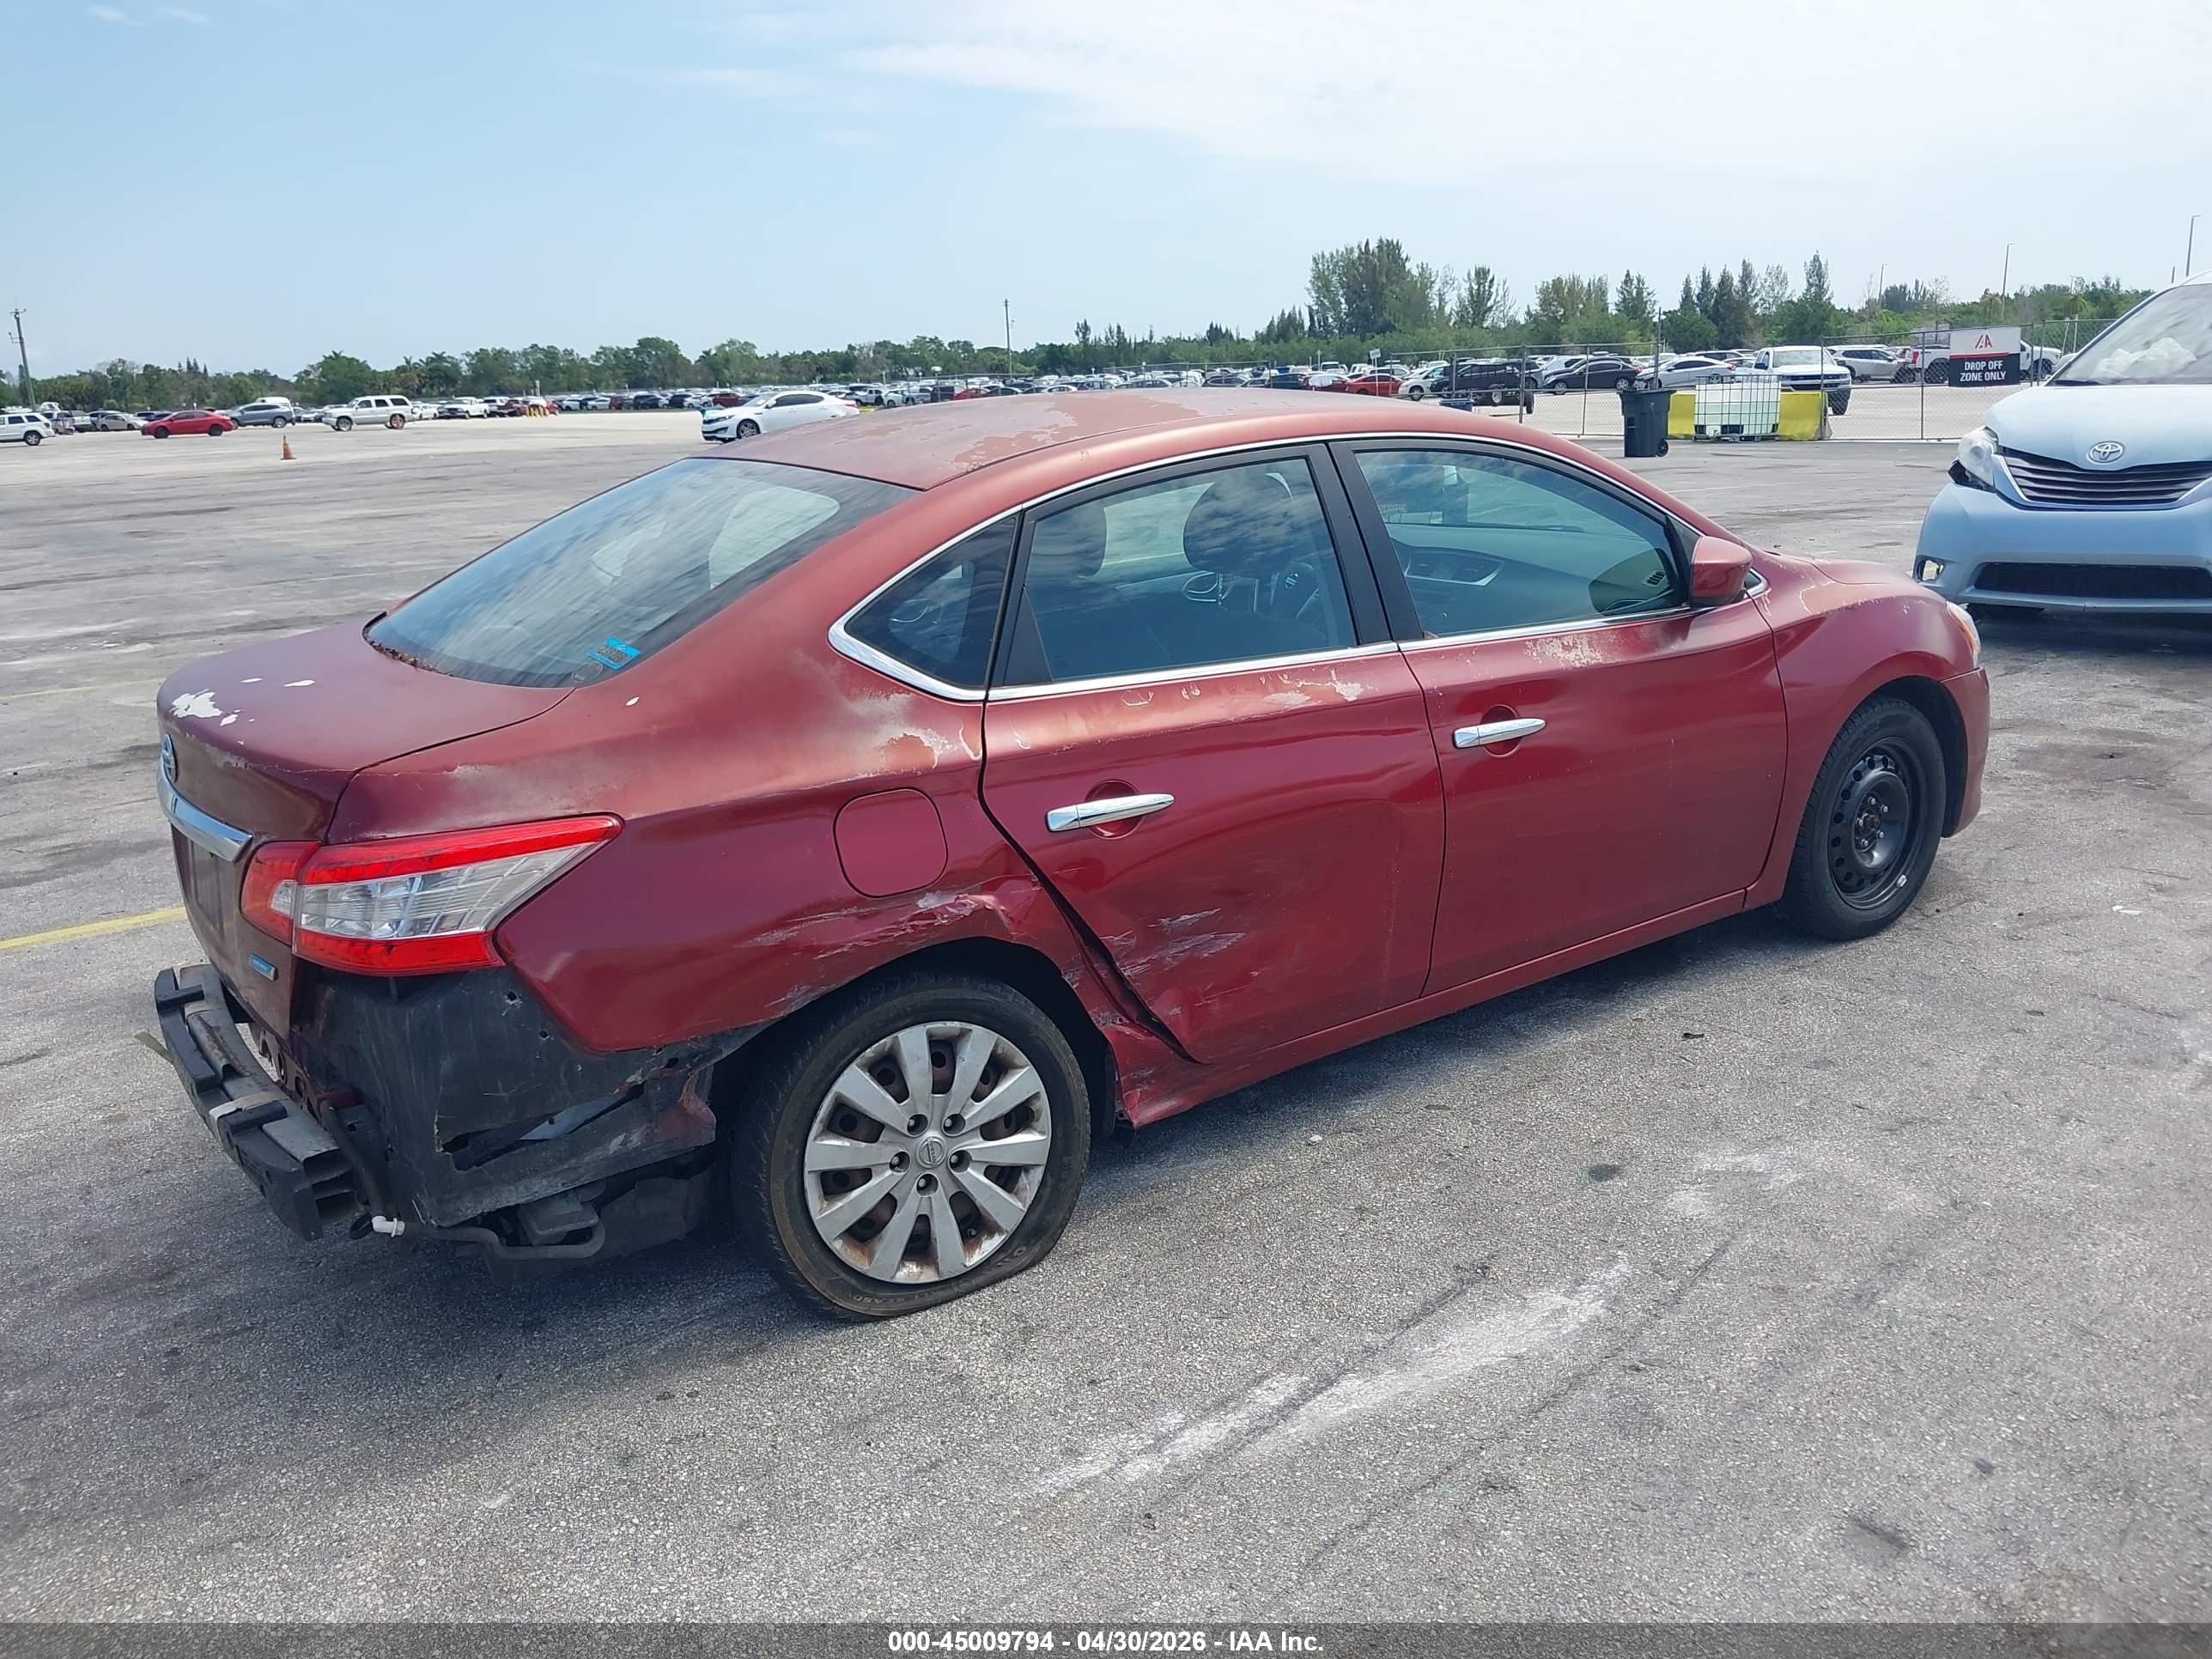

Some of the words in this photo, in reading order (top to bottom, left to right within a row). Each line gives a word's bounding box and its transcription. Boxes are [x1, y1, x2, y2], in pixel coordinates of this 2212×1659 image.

[1965, 362, 1986, 371] DROP
[1988, 361, 2003, 370] OFF
[1960, 372, 1983, 382] ZONE
[1984, 371, 2007, 381] ONLY
